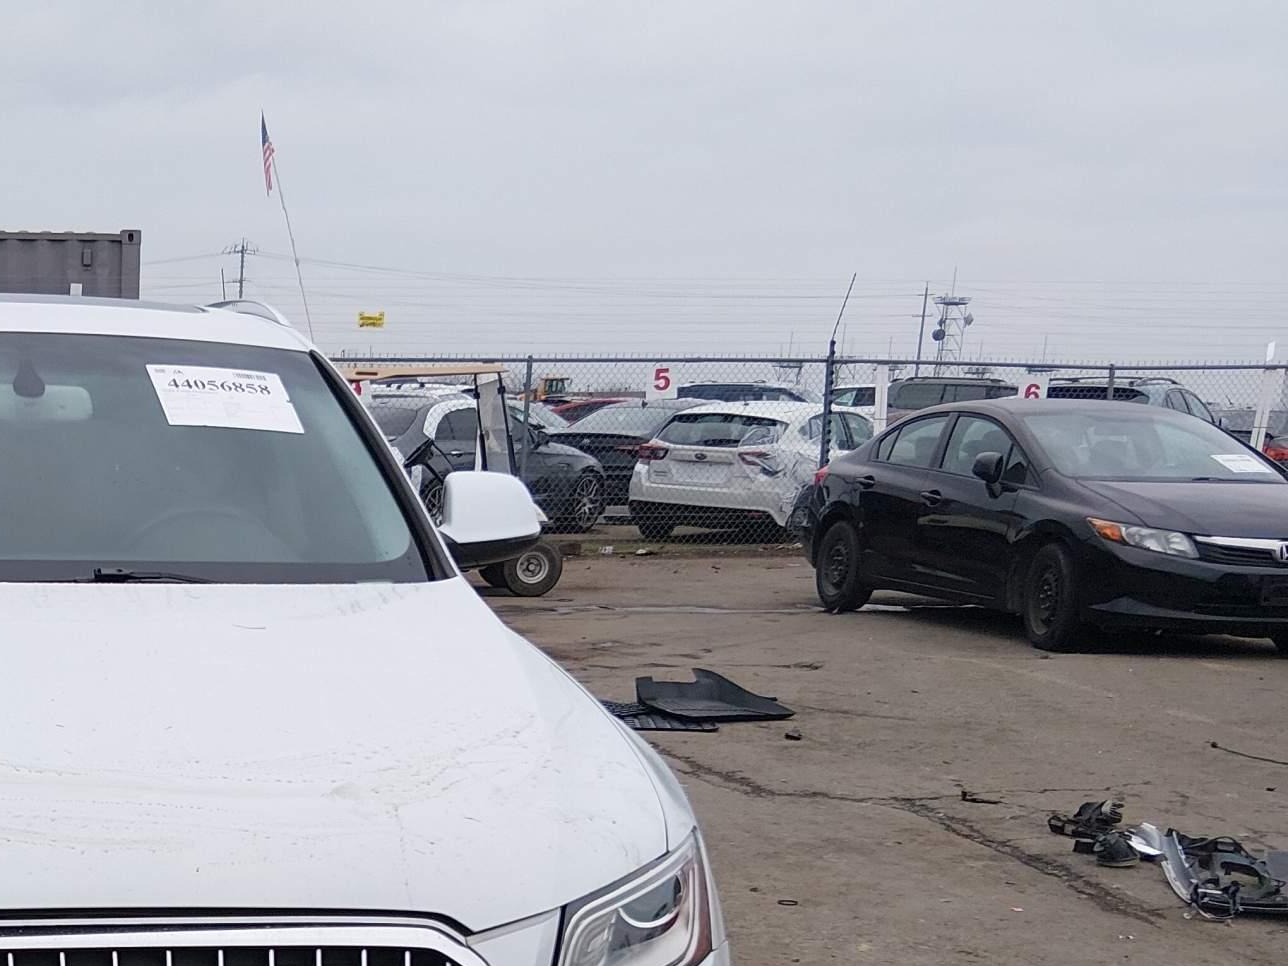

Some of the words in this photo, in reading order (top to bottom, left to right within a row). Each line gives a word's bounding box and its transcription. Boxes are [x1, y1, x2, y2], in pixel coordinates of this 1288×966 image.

[167, 377, 272, 396] 44056858
[654, 367, 671, 391] 5
[1024, 383, 1041, 400] 6
